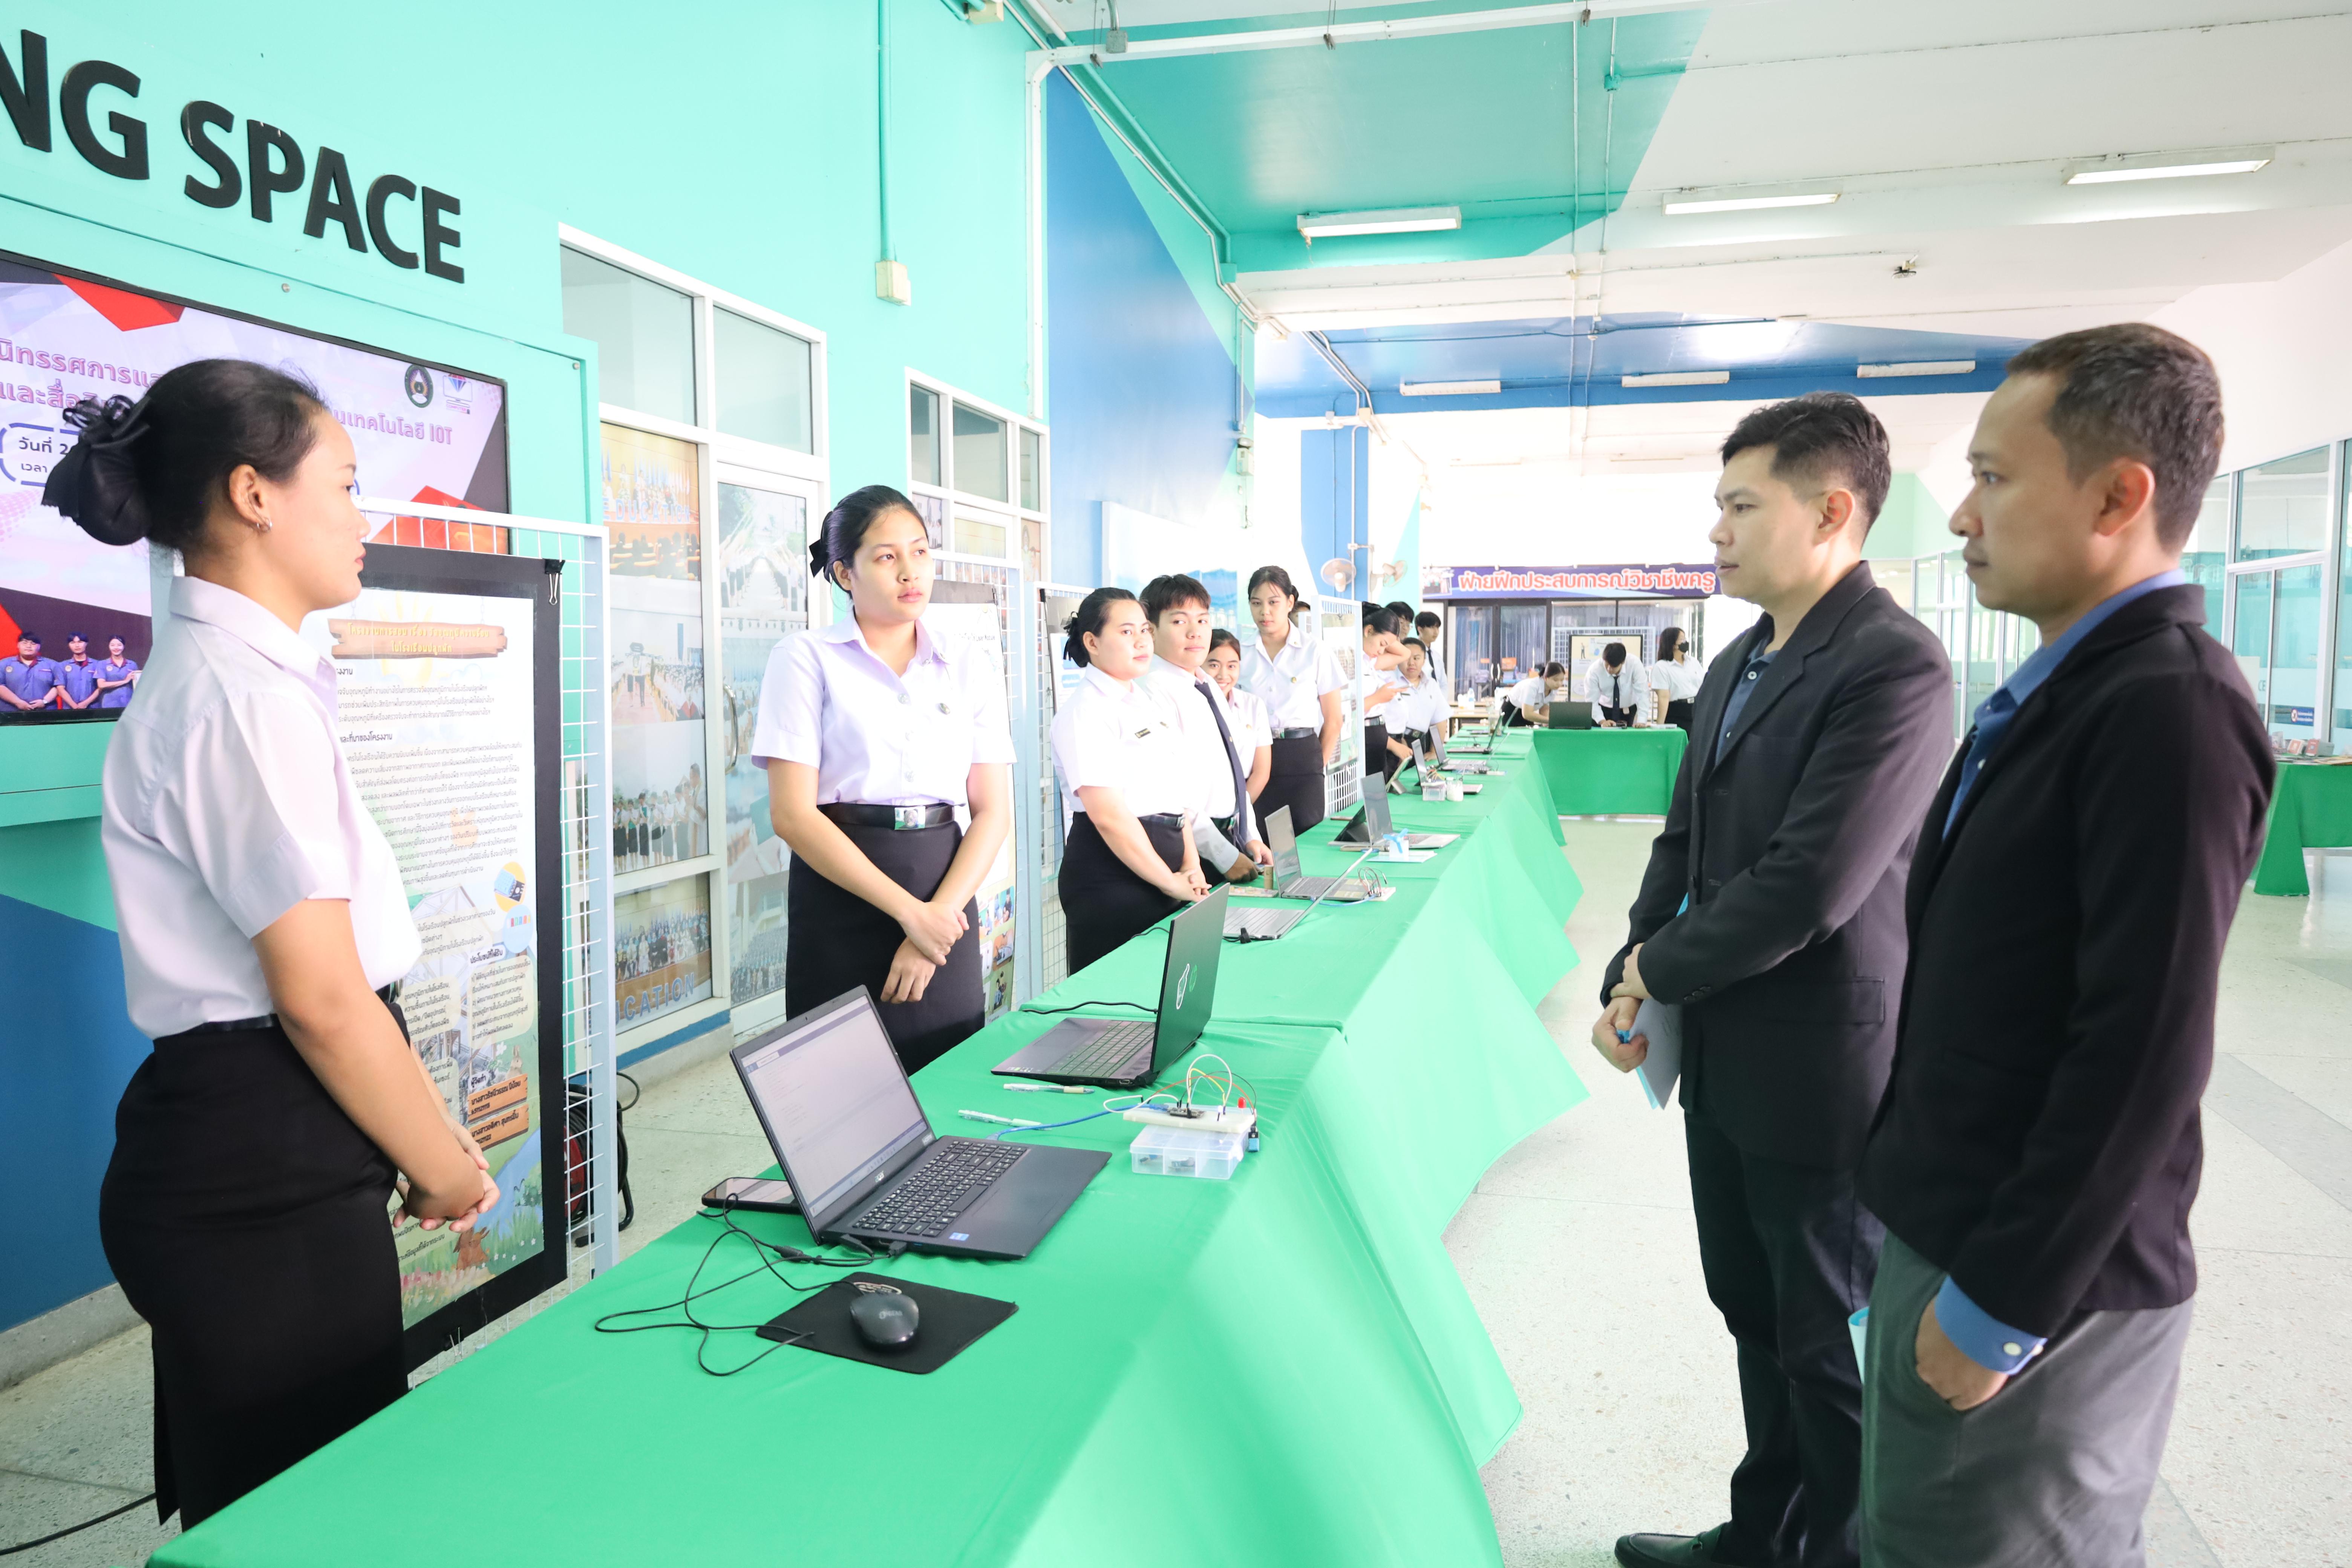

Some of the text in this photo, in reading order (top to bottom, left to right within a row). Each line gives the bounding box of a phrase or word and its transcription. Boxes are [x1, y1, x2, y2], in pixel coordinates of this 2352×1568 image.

[181, 100, 465, 285] SPACE
[19, 436, 52, 453] วันที่
[430, 423, 452, 444] IOT
[21, 463, 47, 473] เวลา
[603, 497, 690, 522] EDUCATION
[1458, 568, 1715, 594] ฝ่ายฝึกประสบการณ์วิชาชีพครู
